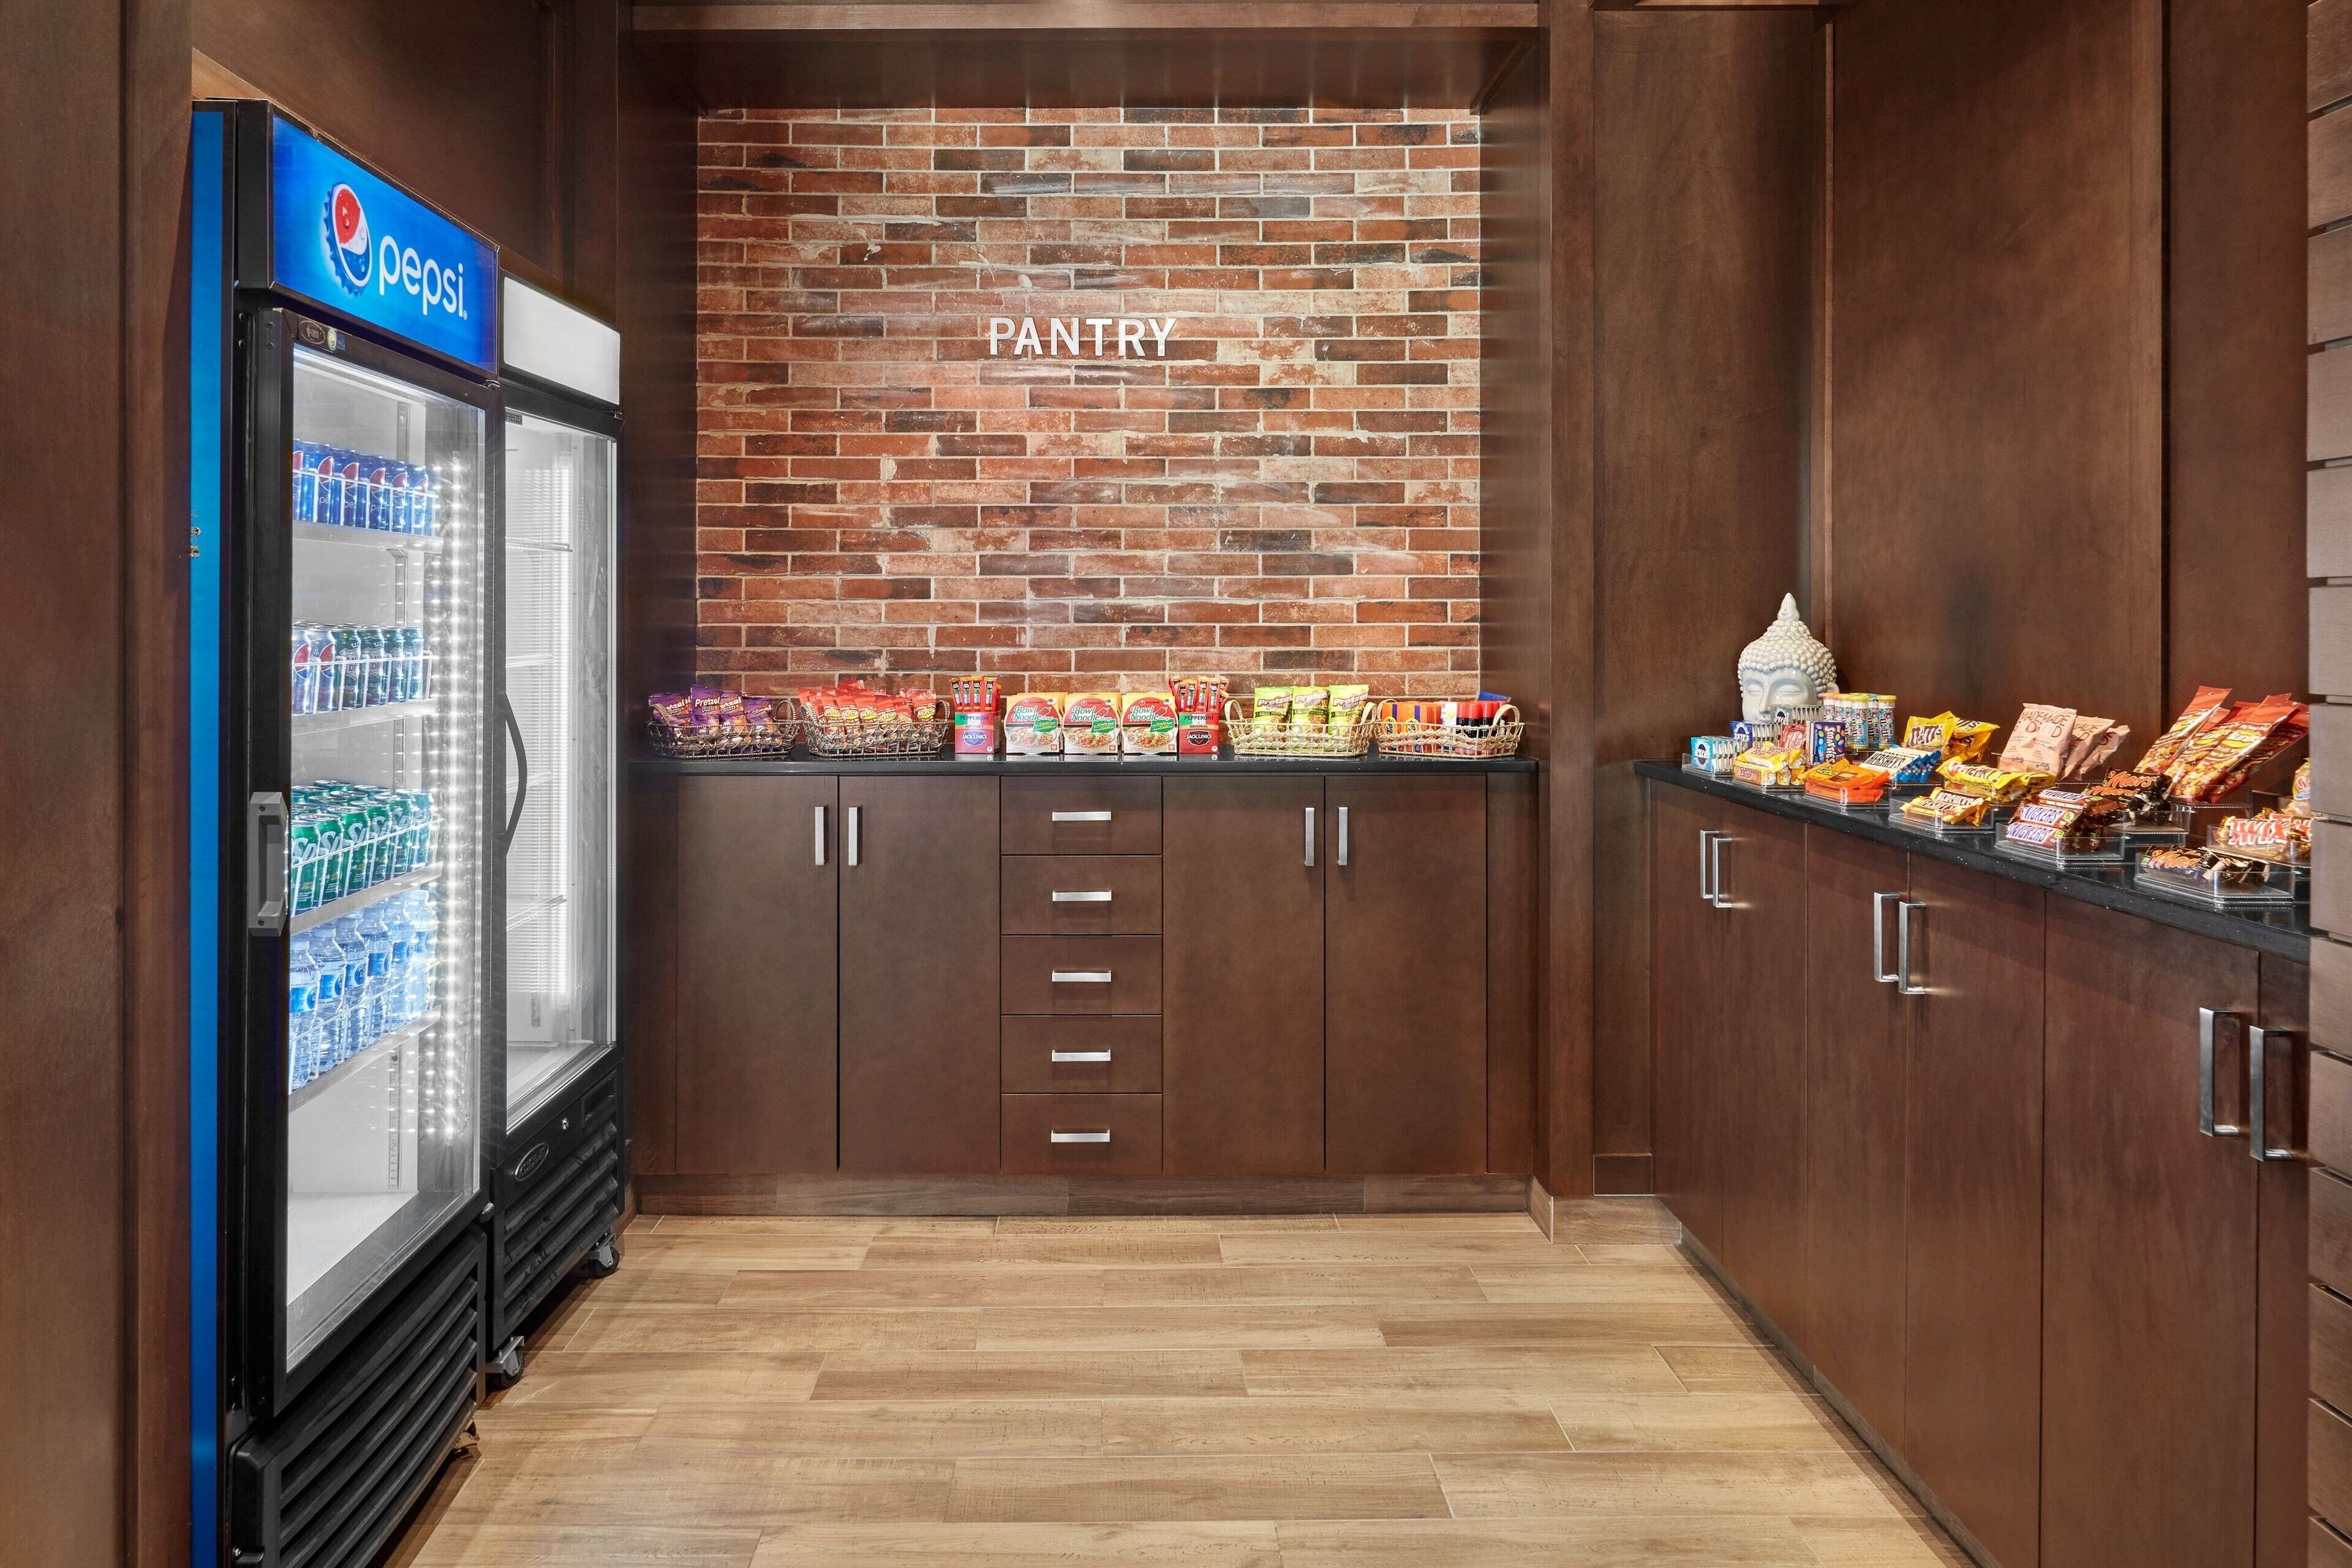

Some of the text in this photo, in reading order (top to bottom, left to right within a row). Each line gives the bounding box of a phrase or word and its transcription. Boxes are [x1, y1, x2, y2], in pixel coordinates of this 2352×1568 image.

[990, 317, 1176, 356] PANTRY
[666, 698, 685, 710] etzel
[695, 696, 721, 707] Pretzel
[720, 696, 742, 709] etzel
[1257, 695, 1292, 707] Pretzel
[1333, 693, 1368, 706] Pretzel
[1014, 705, 1038, 714] Bowl
[1072, 706, 1096, 714] Bowl
[1131, 705, 1155, 714] Bowl
[1069, 714, 1100, 722] Noodle
[2043, 714, 2071, 726] MADE
[1823, 726, 1836, 764] SMARTIES
[1864, 752, 1905, 769] HERSHEY'S
[2105, 771, 2157, 789] Mars
[2007, 823, 2054, 843] SNICKERS
[2228, 820, 2288, 846] TWIX
[2148, 850, 2202, 869] Mar
